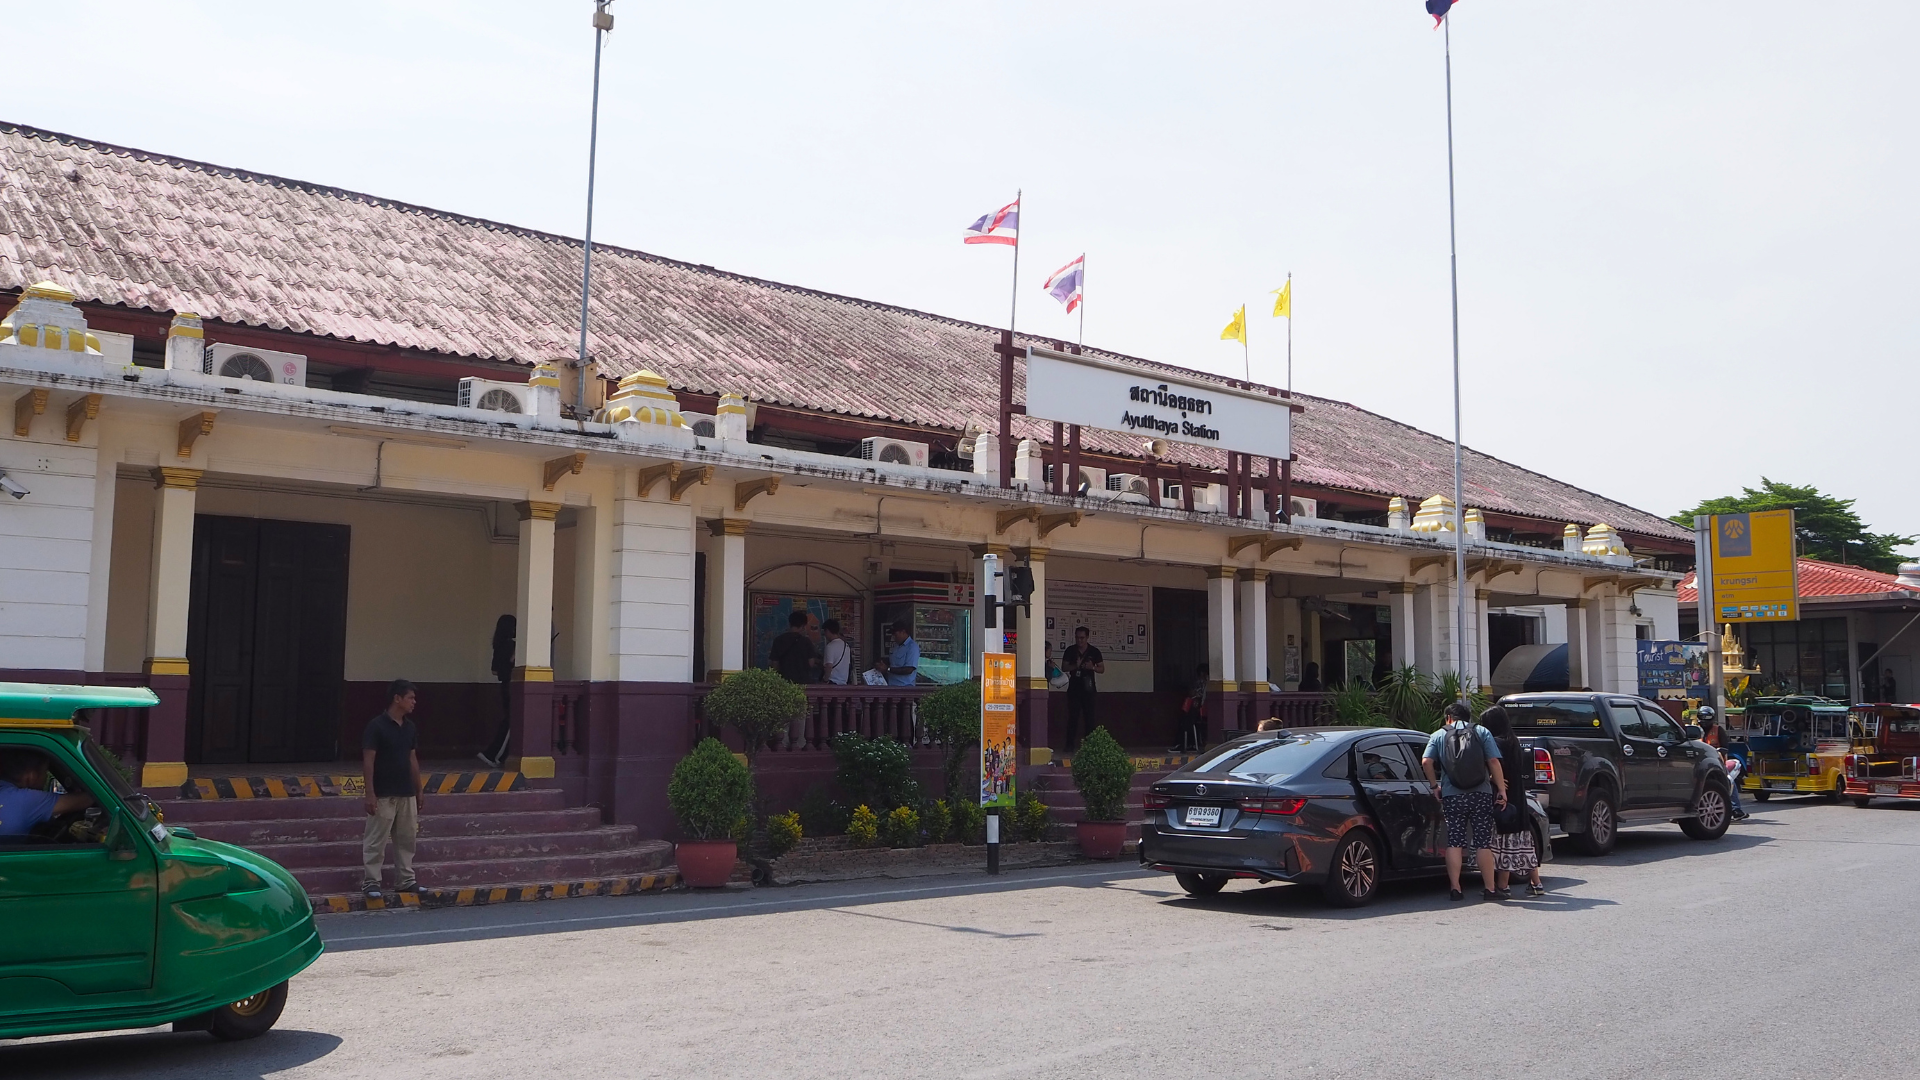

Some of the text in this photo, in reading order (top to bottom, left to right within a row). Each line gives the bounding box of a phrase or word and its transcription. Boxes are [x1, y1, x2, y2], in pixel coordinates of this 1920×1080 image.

[284, 377, 295, 385] LG
[1130, 384, 1212, 418] สถานีอยุธยา
[1121, 410, 1220, 440] Ayutthaya Station
[1720, 576, 1758, 586] krungsri
[1638, 650, 1663, 663] Tourist
